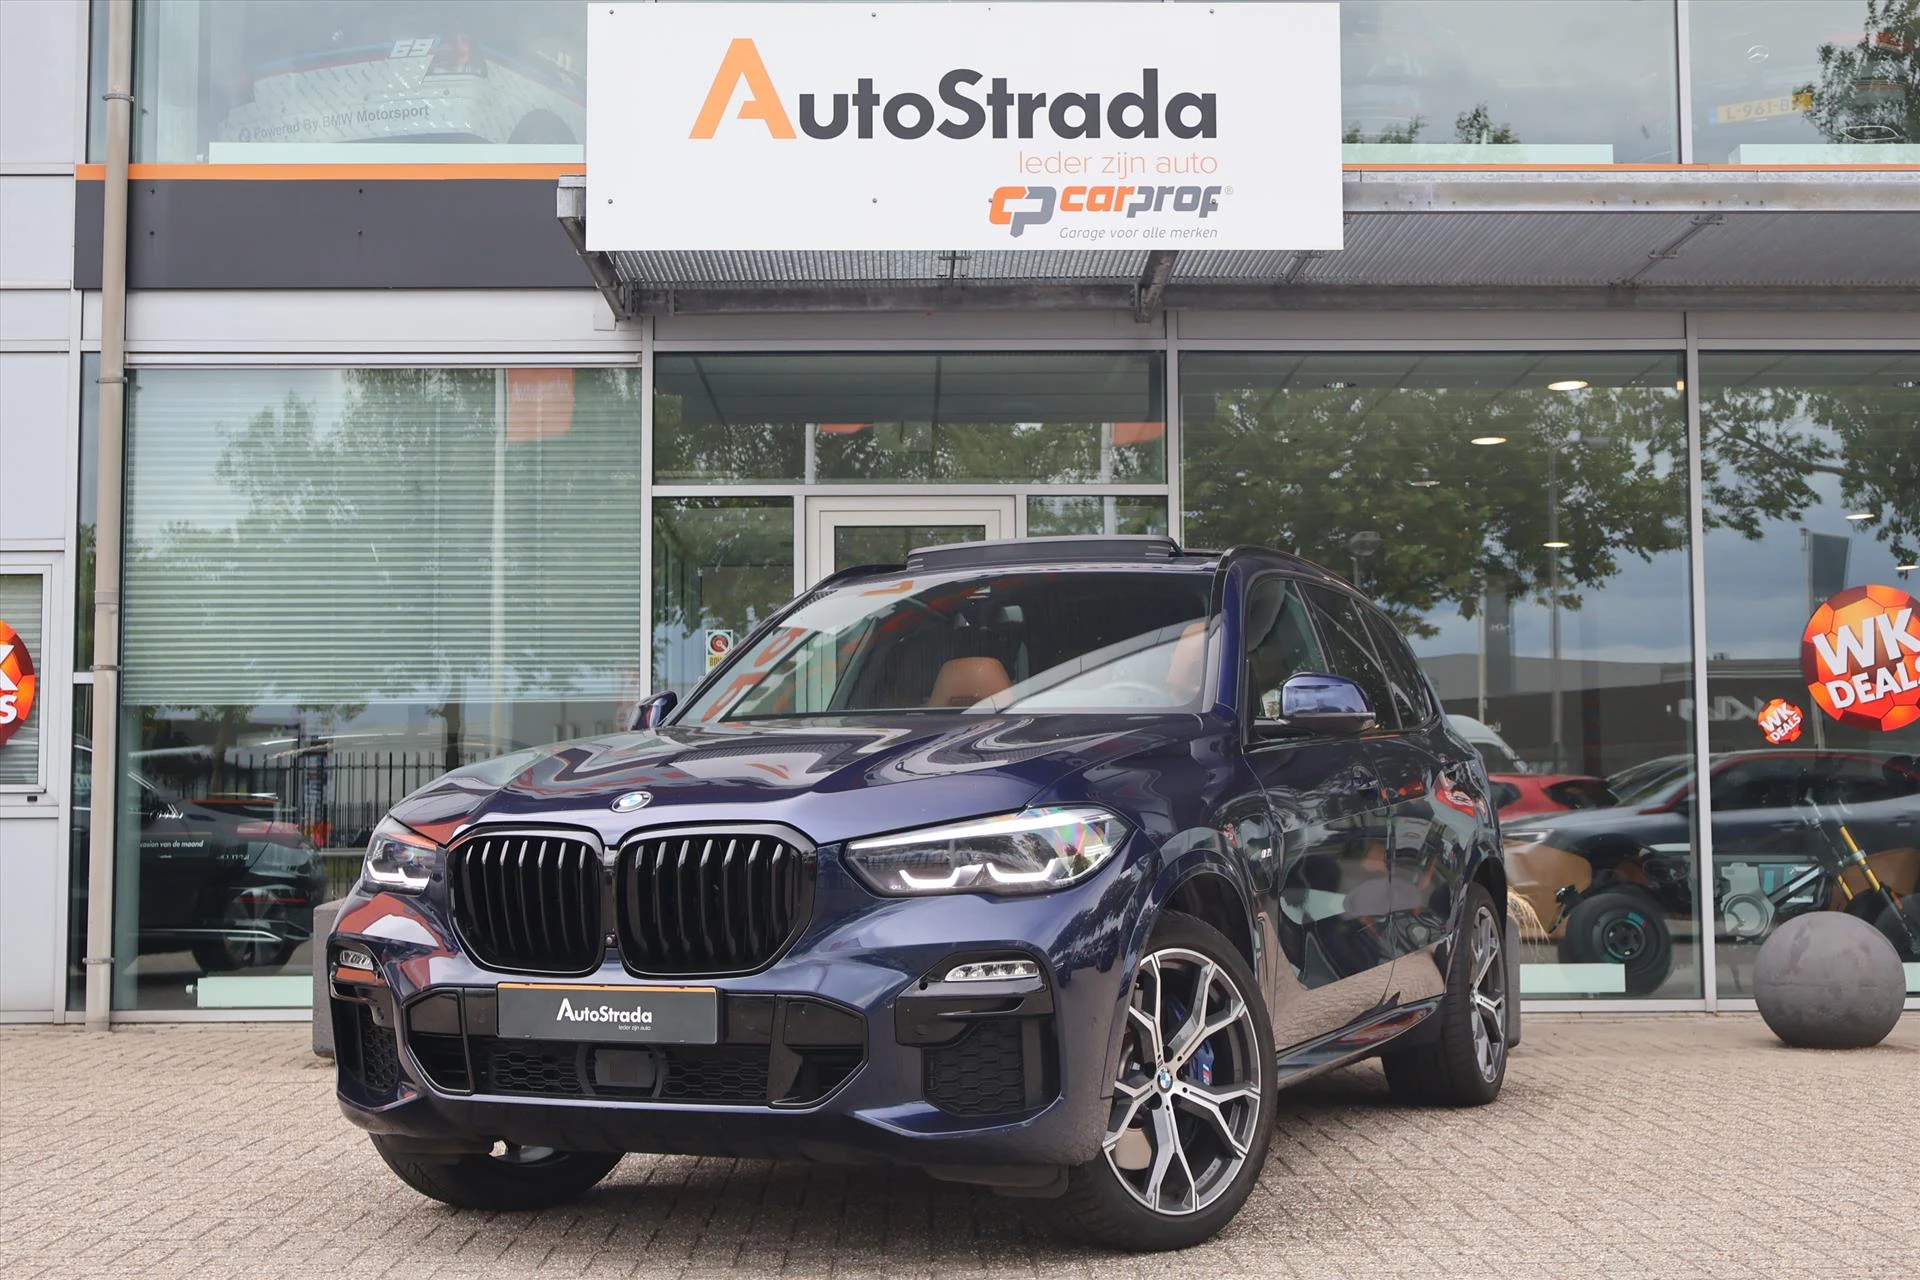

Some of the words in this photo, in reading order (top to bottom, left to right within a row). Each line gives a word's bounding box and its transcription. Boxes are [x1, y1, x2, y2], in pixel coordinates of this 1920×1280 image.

[689, 38, 1218, 140] AutoStrada
[253, 121, 300, 140] Powered
[303, 119, 319, 134] By
[322, 112, 353, 129] BMW
[356, 105, 430, 123] Motorsport
[1726, 96, 1800, 120] L-961-B
[1019, 151, 1093, 174] Ieder
[1101, 151, 1146, 180] zijn
[1155, 152, 1218, 174] auto
[1059, 227, 1106, 241] Garage
[1110, 228, 1139, 239] voor
[1143, 226, 1167, 239] alle
[1170, 226, 1218, 239] merken
[1812, 607, 1920, 676] WK
[1760, 702, 1796, 731] WK
[1769, 712, 1801, 741] DEALS
[172, 840, 181, 848] de
[556, 998, 653, 1023] AutoStrada
